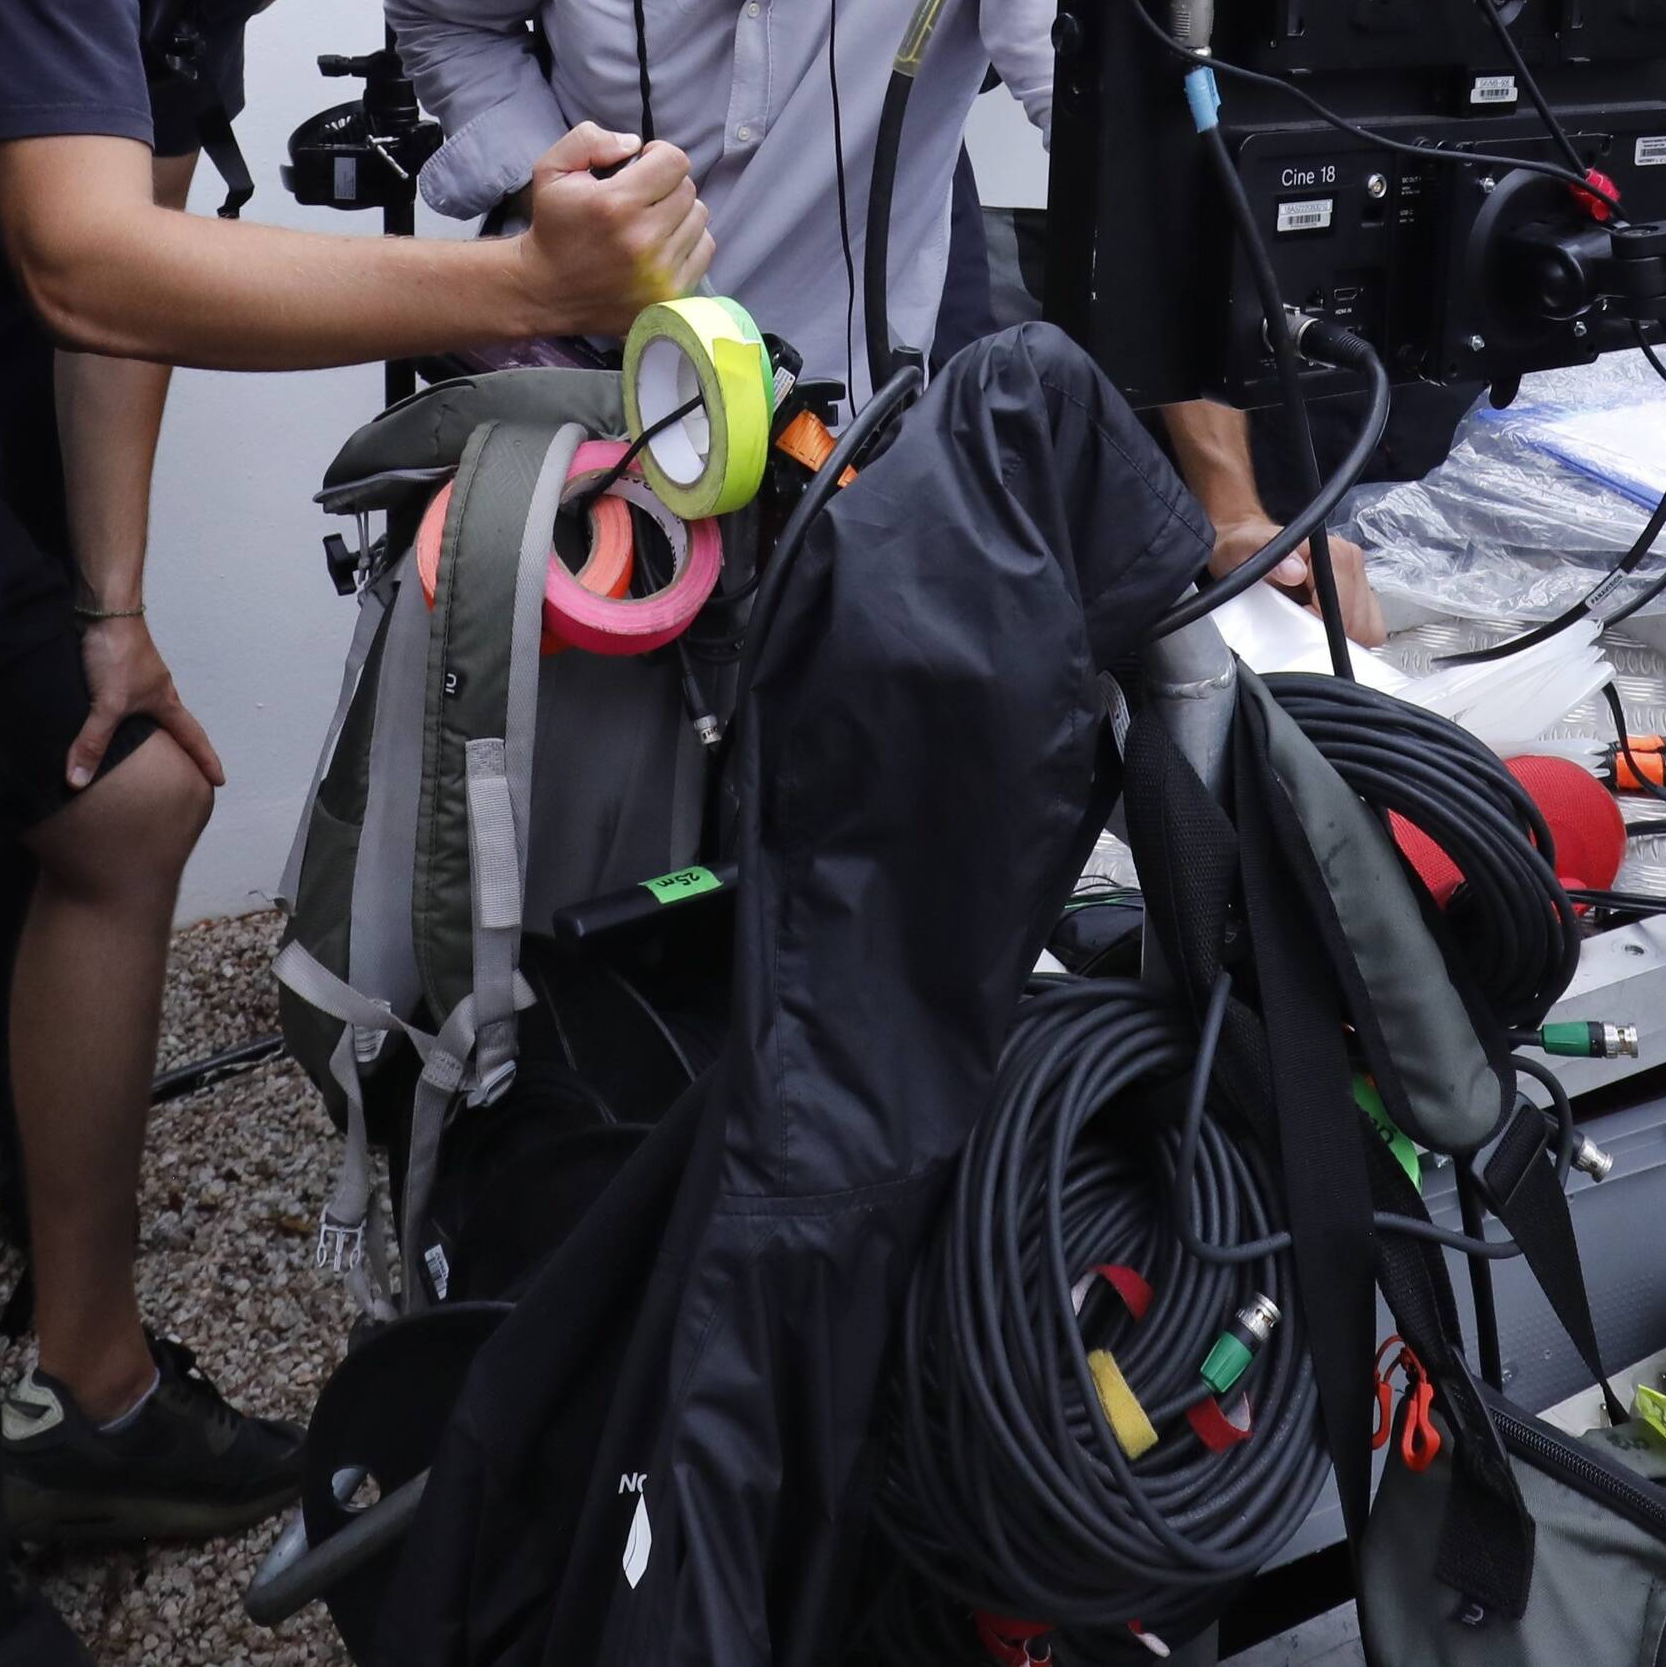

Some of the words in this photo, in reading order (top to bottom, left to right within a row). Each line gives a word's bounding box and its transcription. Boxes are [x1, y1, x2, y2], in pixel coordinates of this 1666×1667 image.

[1281, 167, 1316, 187] Cine
[1320, 165, 1337, 184] 18
[1589, 572, 1624, 606] PANAVISION
[656, 871, 701, 889] 25m
